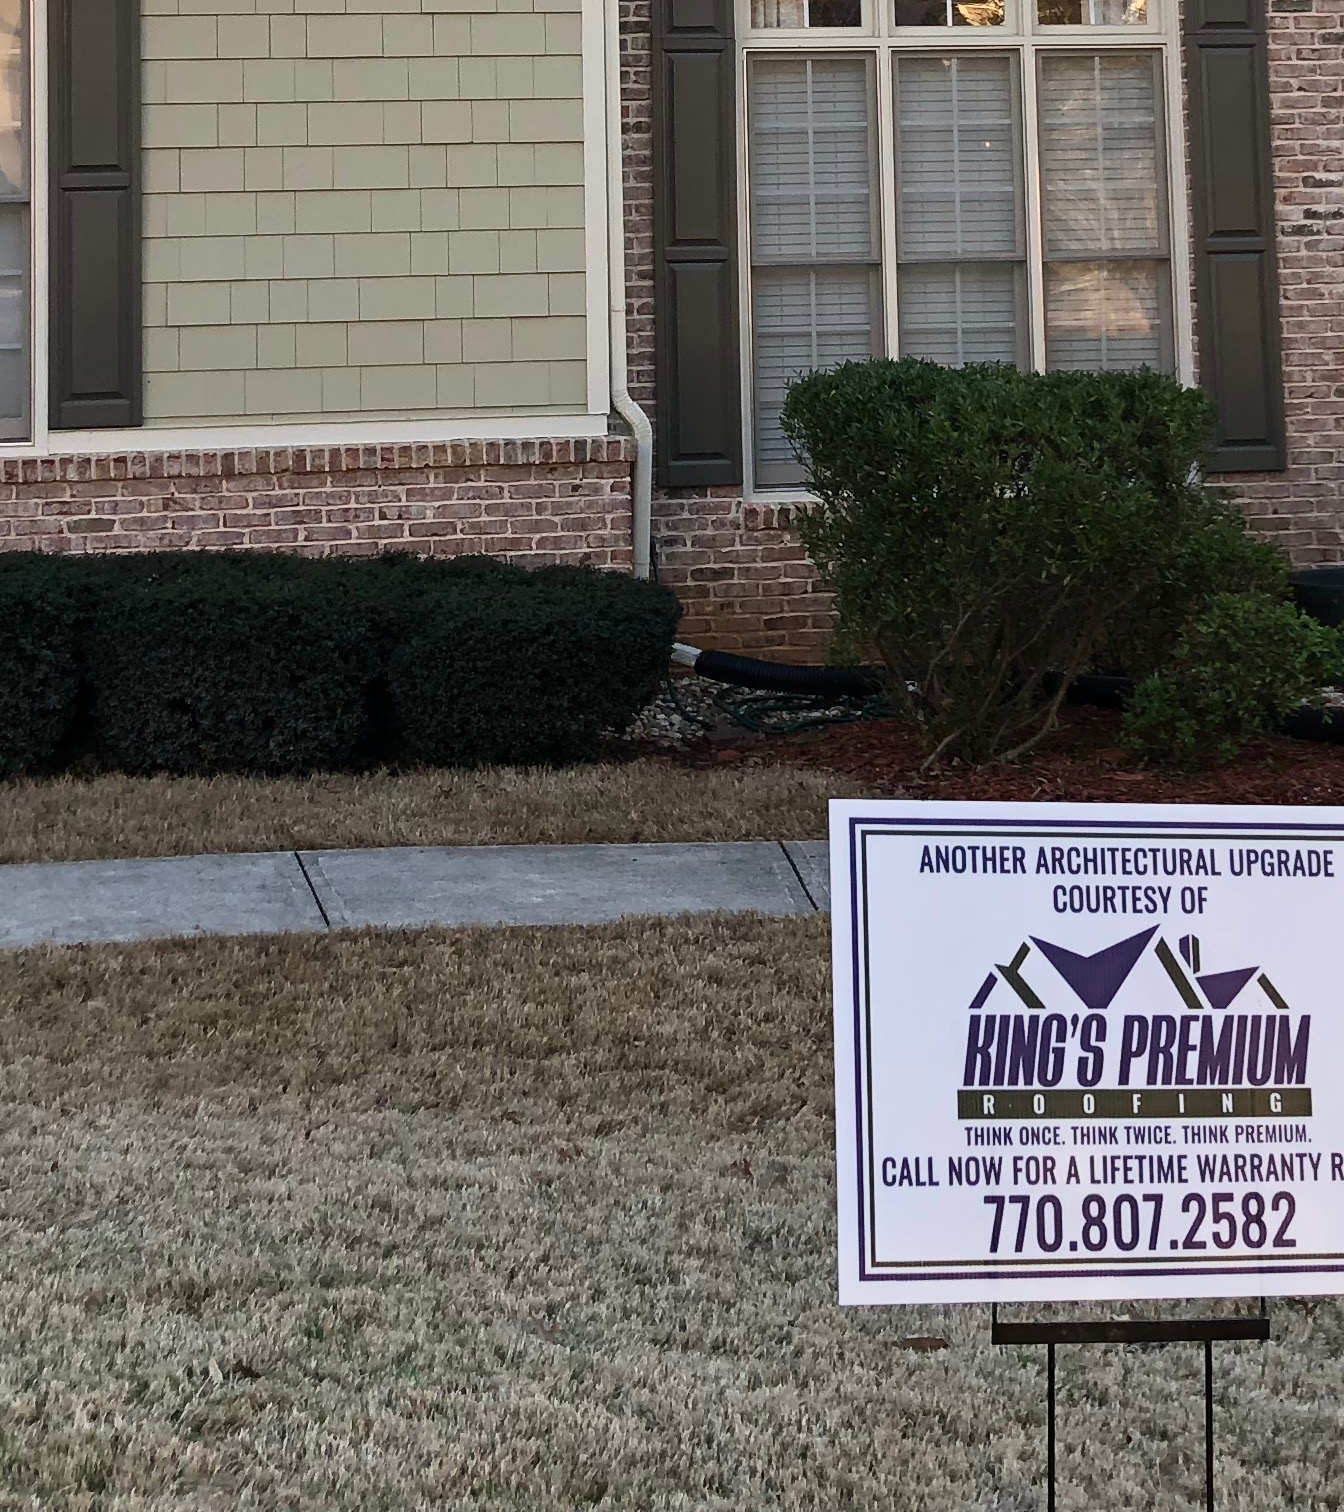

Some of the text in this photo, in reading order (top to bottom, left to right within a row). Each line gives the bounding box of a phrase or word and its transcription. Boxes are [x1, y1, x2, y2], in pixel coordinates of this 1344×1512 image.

[919, 844, 1335, 878] ANOTHER ARCHITECTURAL UPGRADE
[1052, 884, 1209, 915] COURTESY OF
[963, 1013, 1311, 1087] KING'S PREMIUM
[983, 1093, 1283, 1115] ROOFING
[964, 1123, 1312, 1147] THINK ONCE. THINK TWICE. THINK PREMIUM.
[881, 1156, 940, 1187] CALL
[948, 1155, 1003, 1187] NOW
[1012, 1155, 1057, 1186] FOR
[1065, 1155, 1081, 1185] A
[1089, 1154, 1189, 1185] LIFETIME
[1196, 1152, 1322, 1184] WARRANTY
[984, 1192, 1297, 1253] 770.807.2582
